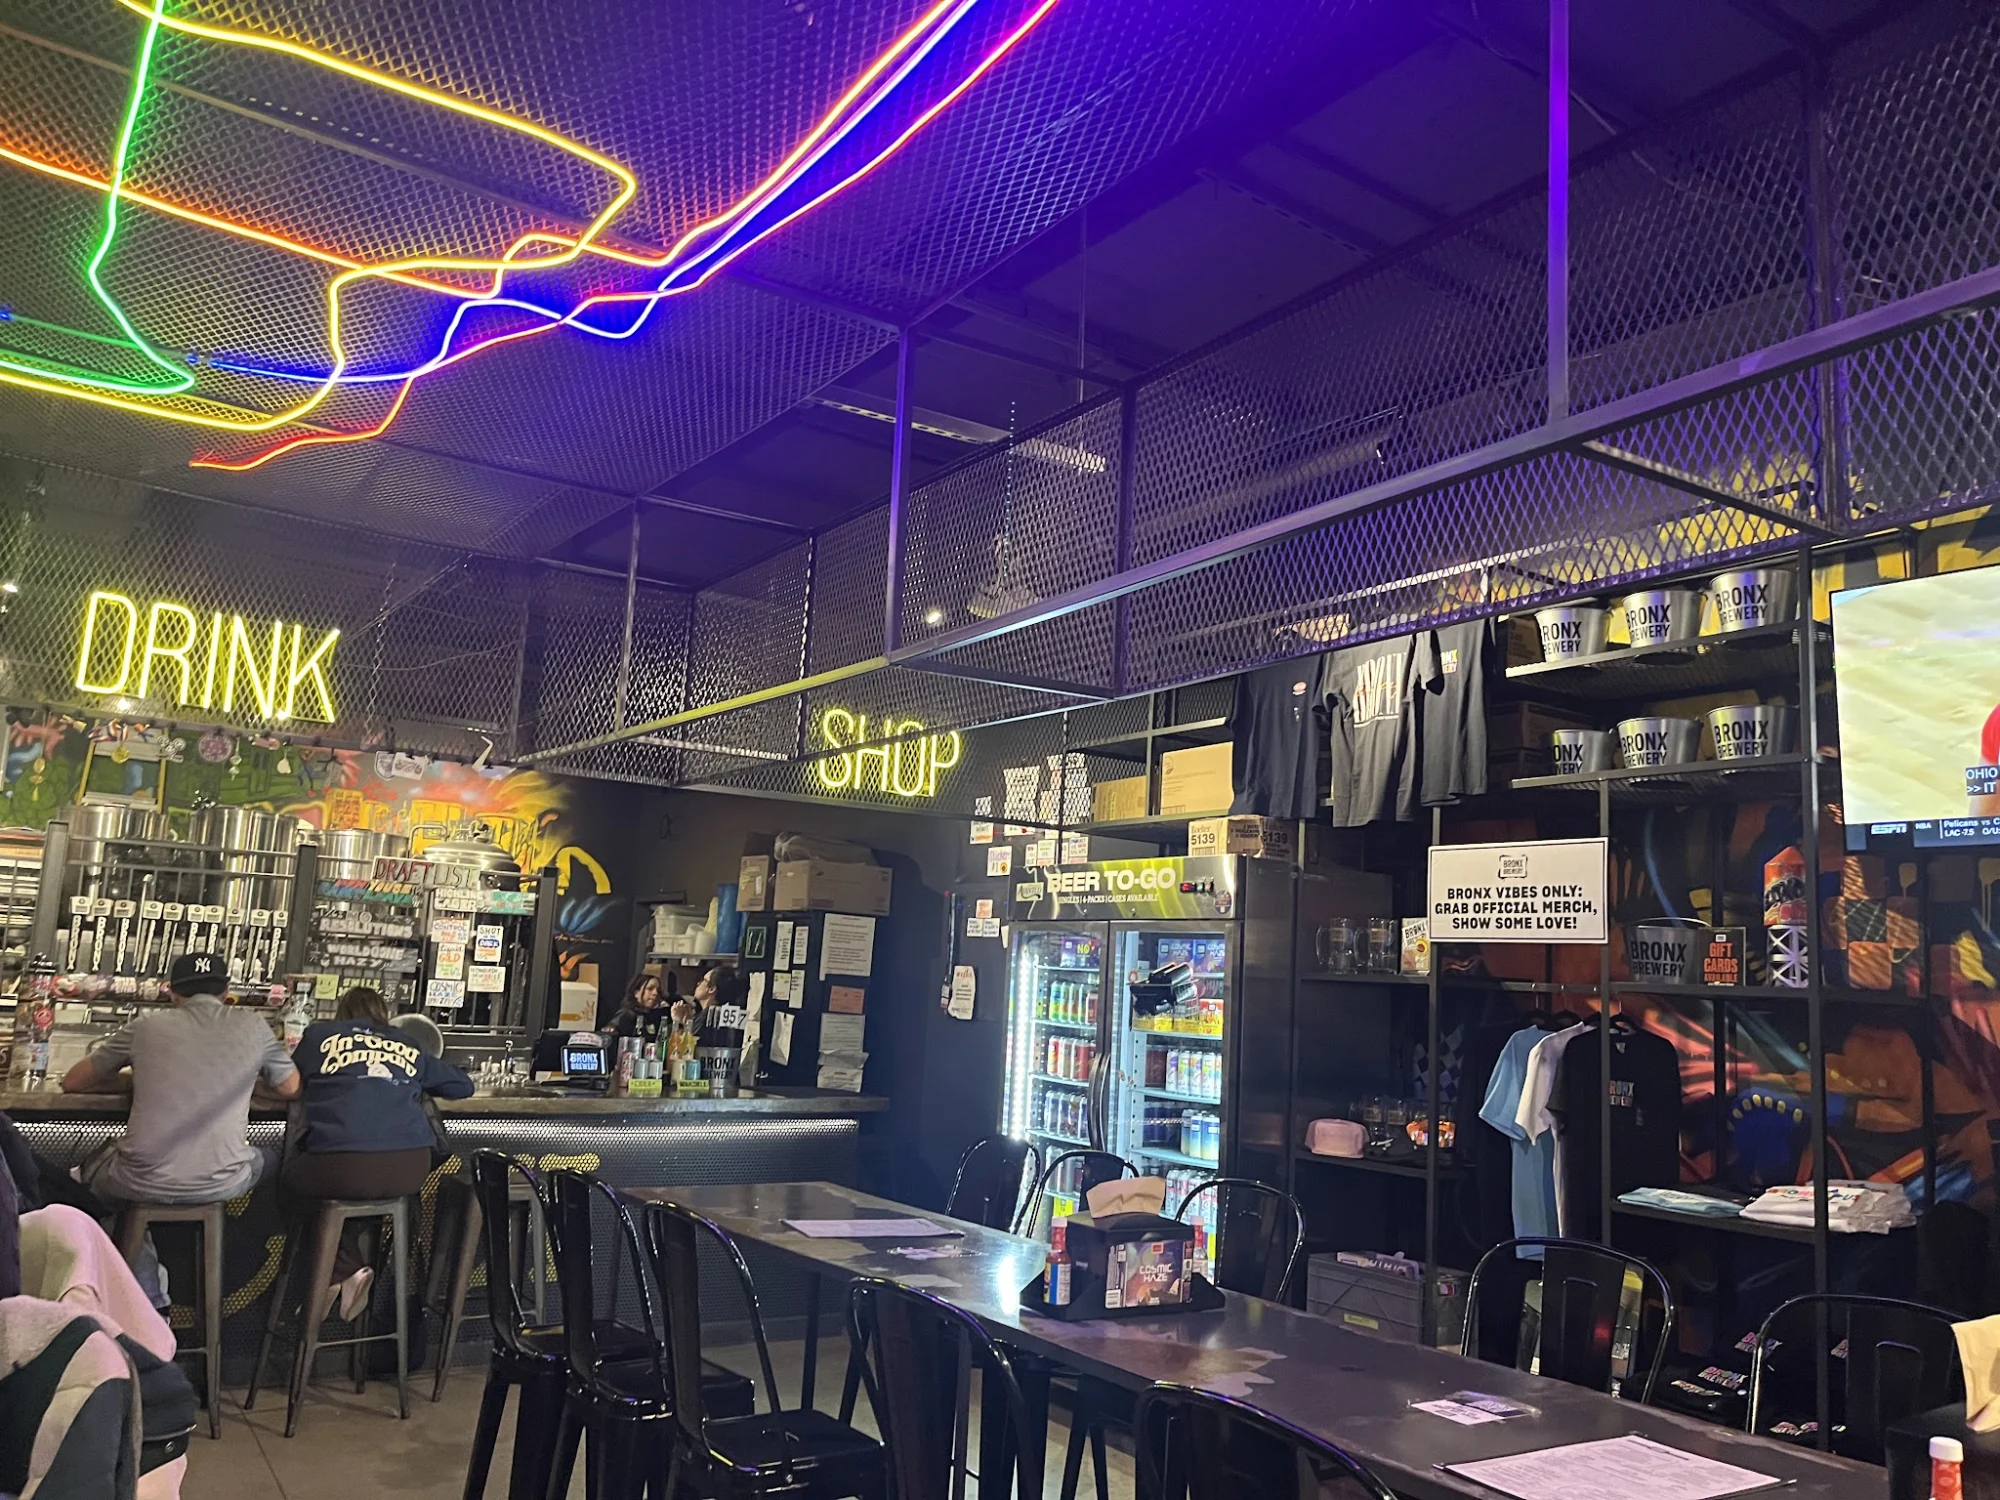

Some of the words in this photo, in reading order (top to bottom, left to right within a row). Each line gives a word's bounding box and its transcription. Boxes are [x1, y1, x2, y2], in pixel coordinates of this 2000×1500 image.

[1716, 584, 1768, 609] BRONX
[1543, 621, 1582, 641] RONX
[1543, 640, 1582, 654] REWERY
[75, 591, 341, 723] DRINK
[1714, 720, 1769, 744] BRONX
[818, 708, 962, 798] SHOP
[1553, 744, 1583, 762] ONX
[1965, 767, 1999, 780] OHIO
[1983, 782, 1997, 793] IT
[1870, 823, 1907, 835] ESPN
[1915, 822, 1932, 830] NBA
[1943, 819, 1979, 829] Pelicans
[1191, 833, 1216, 846] 5139
[1944, 829, 1961, 838] LAC
[1503, 859, 1524, 869] BRONX
[374, 858, 433, 883] DRAFT
[434, 864, 479, 889] LIST
[1047, 871, 1100, 894] BEER
[1104, 867, 1177, 892] TO-GO
[1447, 887, 1492, 900] BRONX
[1496, 886, 1538, 899] VIBES
[1542, 885, 1583, 898] ONLY:
[1435, 902, 1470, 915] GRAB
[1472, 902, 1538, 914] OFFICIAL
[1542, 900, 1598, 916] MERCH,
[319, 918, 413, 939] RESOLUTIONS
[434, 923, 467, 932] CONTROL
[1452, 917, 1491, 930] SHOW
[1495, 917, 1532, 930] SOME
[1537, 917, 1577, 929] LOVE!
[479, 927, 501, 935] SHOT
[1631, 941, 1688, 963] BRONX
[1709, 943, 1733, 958] GIFT
[333, 955, 382, 967] HAZY
[440, 953, 461, 963] GOLD
[1633, 961, 1686, 978] BREWERY
[1704, 958, 1738, 974] CARDS
[1704, 973, 1738, 984] AVAILABLE
[429, 981, 463, 993] COSMIC
[722, 1009, 737, 1024] 95
[320, 1033, 354, 1054] In
[354, 1033, 420, 1064] Good
[569, 1052, 598, 1064] BRONX
[700, 1056, 736, 1070] BRONX
[1609, 1080, 1635, 1097] RONX
[1140, 1264, 1173, 1275] COSMIC
[1143, 1273, 1168, 1282] HAZE
